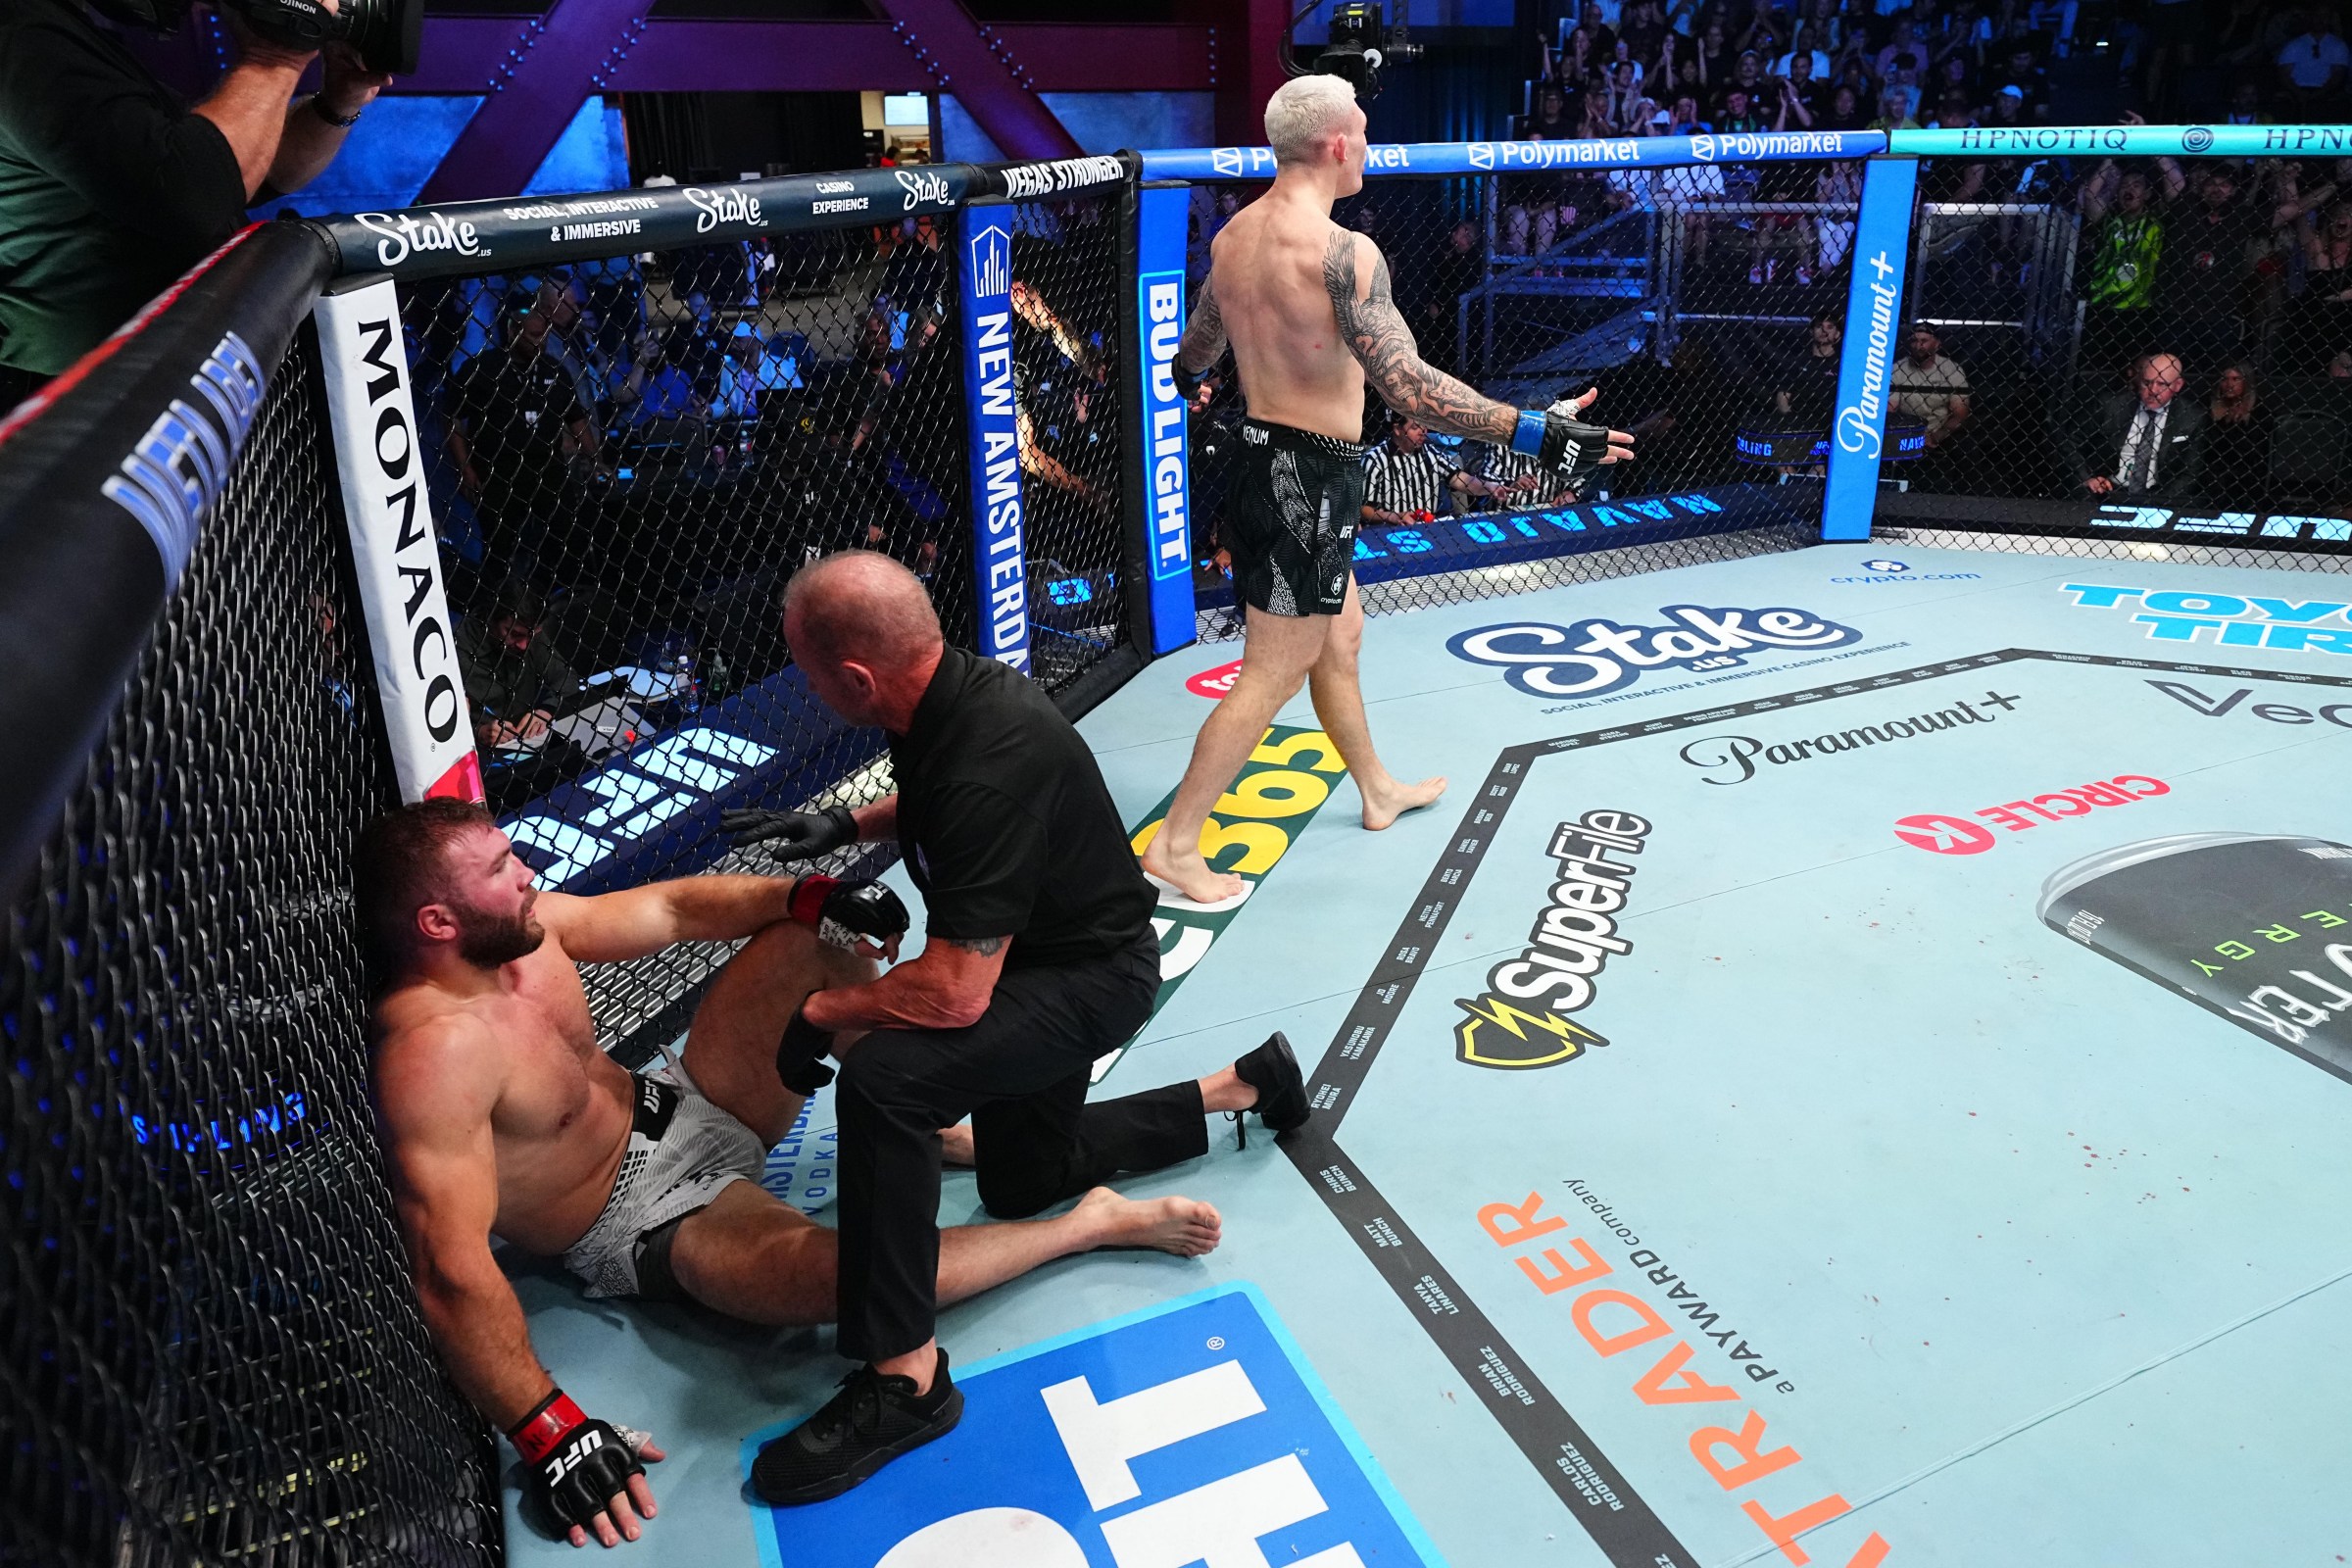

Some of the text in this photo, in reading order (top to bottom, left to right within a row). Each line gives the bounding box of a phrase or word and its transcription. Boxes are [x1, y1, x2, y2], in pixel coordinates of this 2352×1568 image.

[1502, 140, 1642, 167] Polymarket
[1721, 132, 1842, 158] Polymarket
[1961, 128, 2128, 151] HPNOTIQ
[816, 180, 855, 194] CASINO
[895, 170, 950, 211] Stake
[1004, 156, 1124, 198] VEGAS STRONGER
[502, 196, 660, 220] SOCIAL, INTERACTIVE
[683, 186, 761, 233] Stake
[812, 197, 869, 215] EXPERIENCE
[354, 211, 479, 266] Stake
[550, 219, 641, 242] & IMMERSIVE
[1837, 250, 1897, 460] Paramount+
[1150, 282, 1188, 564] BUD LIGHT
[1243, 424, 1270, 448] VENUM
[1558, 439, 1582, 475] UFC
[977, 311, 1029, 679] NEW AMSTERDA
[358, 317, 459, 744] MONACO
[1462, 494, 1727, 544] NAVAJO
[2090, 506, 2352, 541] UFC
[1830, 572, 1983, 584] crypto.com
[2058, 582, 2352, 624] TOY
[1462, 609, 1845, 694] Stake
[1541, 701, 1600, 715] SOCIAL,
[1601, 684, 1692, 707] INTERACTIVE
[1707, 667, 1782, 687] IMMERSIVE
[1783, 656, 1834, 670] CASINO
[1834, 640, 1911, 662] EXPERIENCE
[1679, 690, 2022, 786] Paramount+
[495, 728, 780, 892] UFC
[1974, 774, 2171, 832] CIRCLE
[1396, 947, 1411, 960] ROSA
[1404, 946, 1420, 963] BRAVO
[2190, 903, 2352, 977] ERGY
[1382, 983, 1399, 1004] MOORE
[1340, 1025, 1365, 1057] YASUNOBU
[1348, 1026, 1376, 1060] YAMAKAWA
[1310, 1083, 1332, 1109] RYOHEI
[1321, 1087, 1343, 1110] MIURA
[803, 1132, 839, 1217] VODKA
[1319, 1169, 1346, 1194] CHRIS
[1328, 1164, 1357, 1193] BUNCH
[1363, 1224, 1390, 1248] MATT
[1372, 1216, 1403, 1247] BUNCH
[1413, 1283, 1443, 1315] TANYA
[1420, 1274, 1460, 1315] LINARES
[1562, 1179, 1795, 1395] a PAYWARD company
[1478, 1362, 1512, 1397] BRIAN
[1479, 1345, 1536, 1406] RODRIGUEZ
[545, 1429, 604, 1488] UFC
[1560, 1442, 1625, 1511] RODRIGUEZ
[1555, 1456, 1602, 1506] CARLOS
